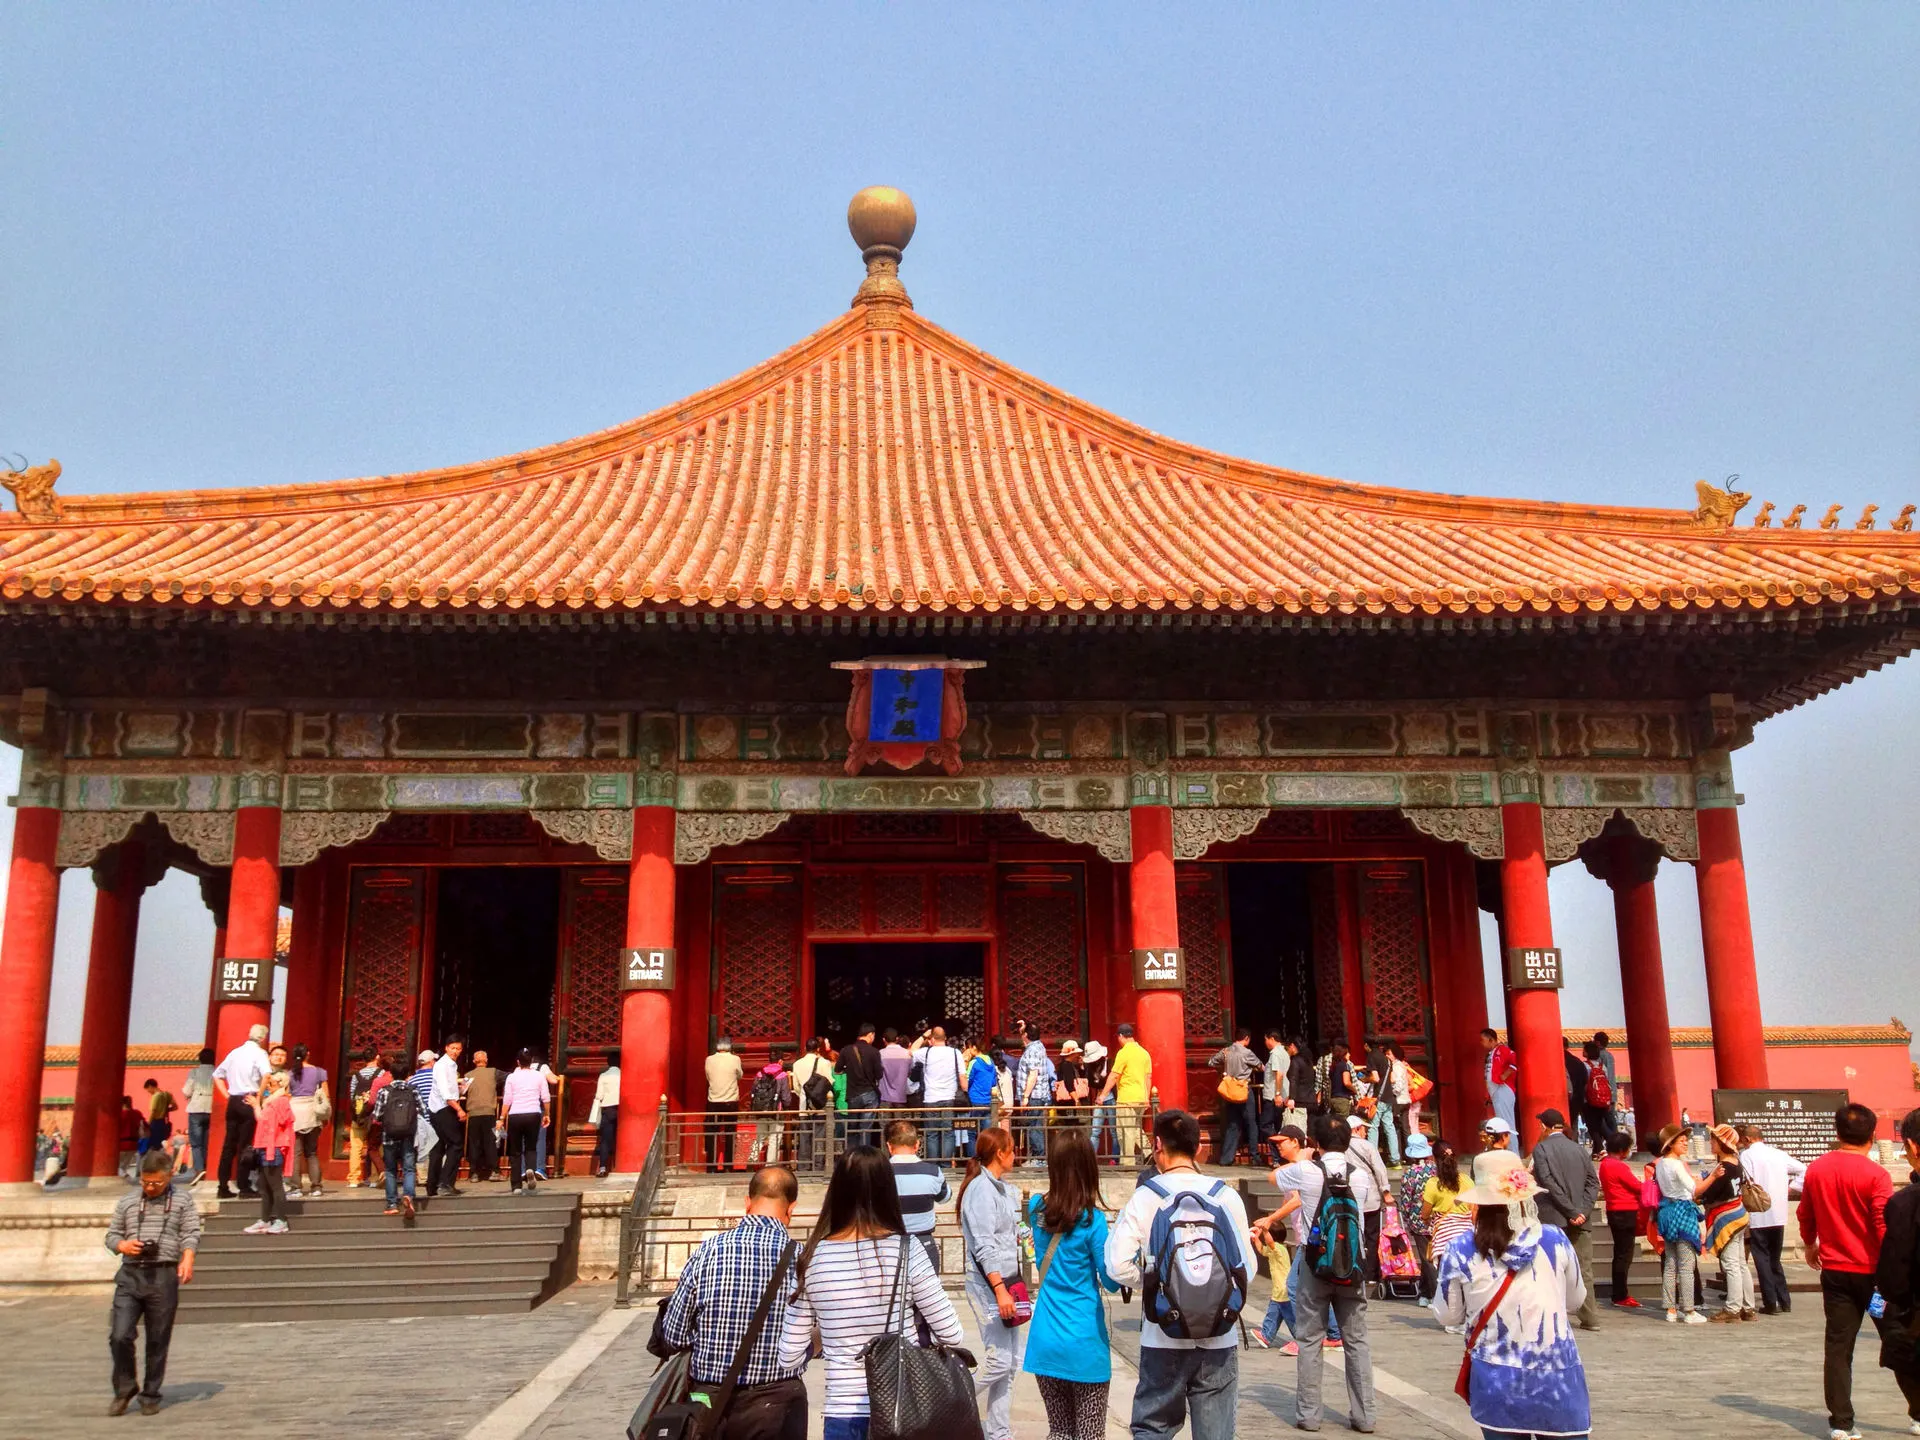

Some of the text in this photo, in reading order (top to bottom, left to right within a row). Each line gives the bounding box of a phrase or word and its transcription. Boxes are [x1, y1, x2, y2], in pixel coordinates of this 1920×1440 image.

[629, 951, 664, 968] 入口
[1144, 951, 1177, 968] 入口
[1525, 951, 1556, 967] 出口
[223, 961, 259, 979] 出口
[629, 969, 663, 980] ENTRANCE
[1145, 969, 1177, 980] ENTRANCE
[1527, 968, 1557, 979] EXIT
[223, 979, 257, 991] EXIT
